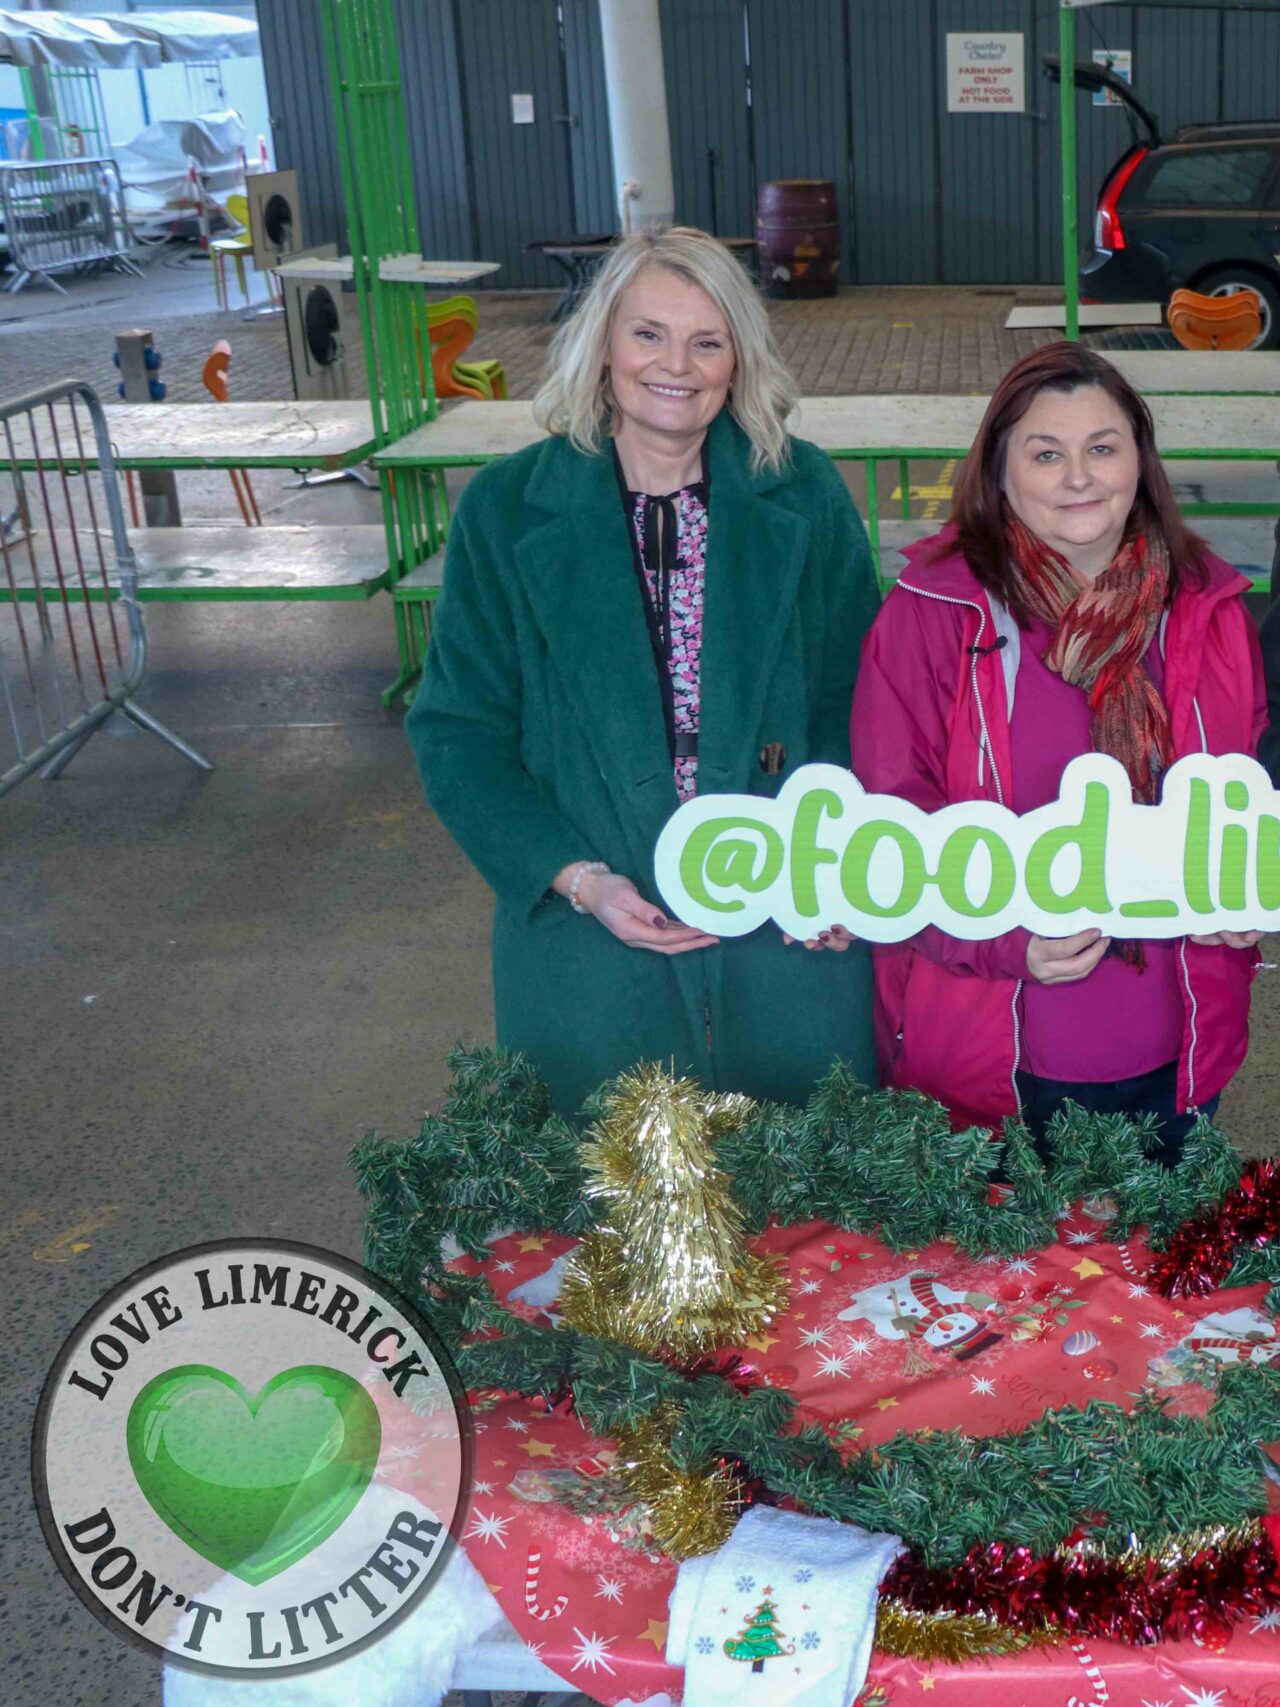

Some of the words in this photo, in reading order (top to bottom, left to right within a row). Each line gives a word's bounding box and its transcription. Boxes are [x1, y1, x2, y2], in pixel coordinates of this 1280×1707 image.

[964, 41, 1007, 53] Country
[959, 67, 985, 75] FARM
[987, 67, 1013, 75] SHOP
[974, 76, 998, 84] ONLY
